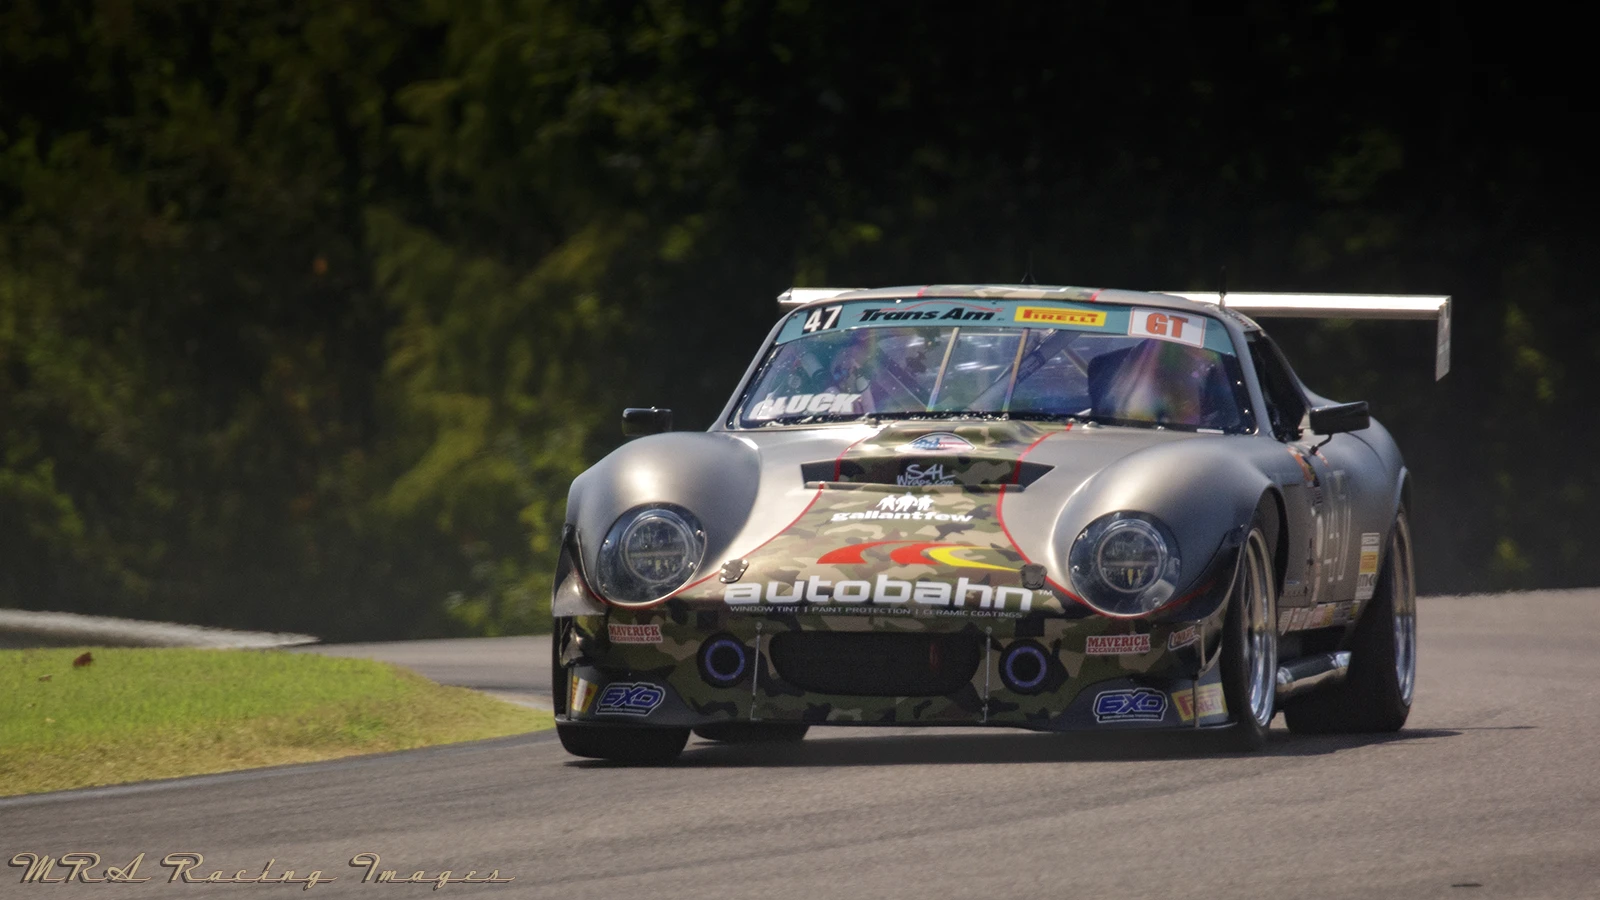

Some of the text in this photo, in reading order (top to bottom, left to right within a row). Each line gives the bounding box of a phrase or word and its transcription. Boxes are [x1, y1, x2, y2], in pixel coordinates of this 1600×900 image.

[803, 304, 843, 332] 47
[859, 307, 996, 322] Trans Am
[1023, 309, 1099, 323] PIRELLI
[1145, 313, 1189, 339] GT
[830, 510, 974, 522] gallantfew
[724, 574, 1033, 611] autobahn
[730, 605, 774, 613] WINDOW
[812, 606, 842, 614] PAINT
[845, 607, 911, 615] PROTECTION
[923, 609, 968, 617] CERAMIC
[971, 610, 1022, 618] COATINGS
[609, 625, 660, 636] MAVERICK
[1088, 635, 1149, 647] MAVERICK
